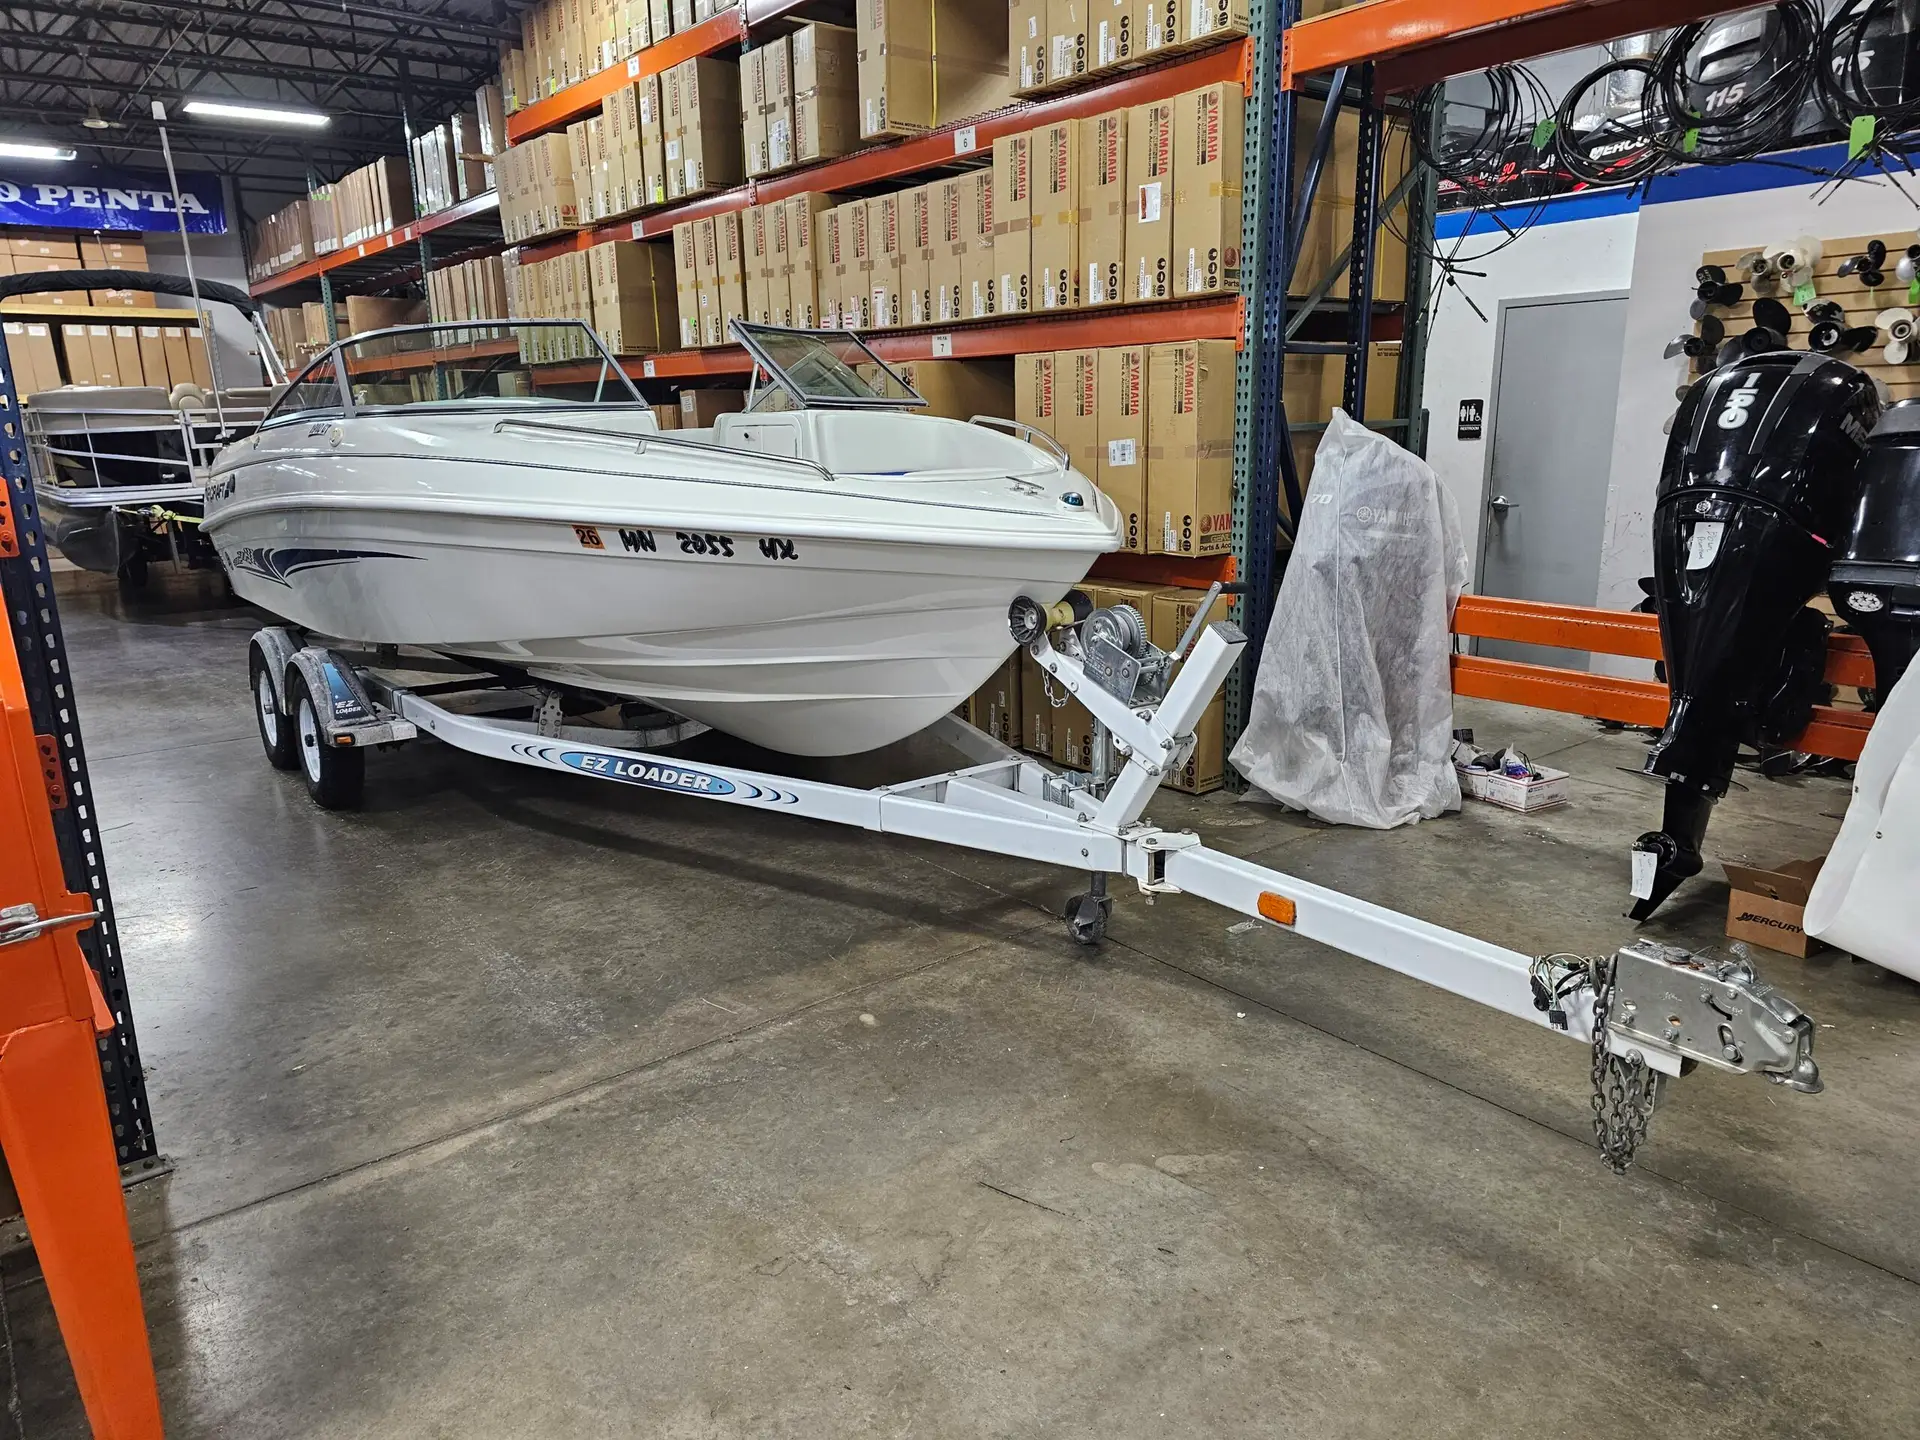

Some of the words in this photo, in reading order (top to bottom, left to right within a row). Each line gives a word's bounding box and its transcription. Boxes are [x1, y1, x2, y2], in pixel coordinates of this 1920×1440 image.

[1705, 83, 1747, 112] 115
[964, 138, 967, 147] 6
[1158, 120, 1169, 176] YAMAHA
[1207, 105, 1218, 162] YAMAHA
[1108, 130, 1117, 184] YAMAHA
[1502, 162, 1516, 174] 90
[32, 184, 209, 214] PENTA
[984, 184, 992, 233] YAMAHA
[888, 210, 896, 252] YAMAHA
[941, 344, 945, 352] 7
[1085, 368, 1093, 416] YAMAHA
[1130, 366, 1139, 416] YAMAHA
[1184, 362, 1194, 413] YAMAHA
[1717, 372, 1762, 430] 150
[1310, 494, 1333, 504] 70
[575, 529, 600, 546] 26
[618, 528, 658, 553] MN
[1200, 544, 1214, 552] Parts
[336, 700, 355, 708] EZ
[580, 755, 610, 772] EZ
[614, 761, 713, 791] LOADER
[1735, 912, 1803, 934] MERCURY
